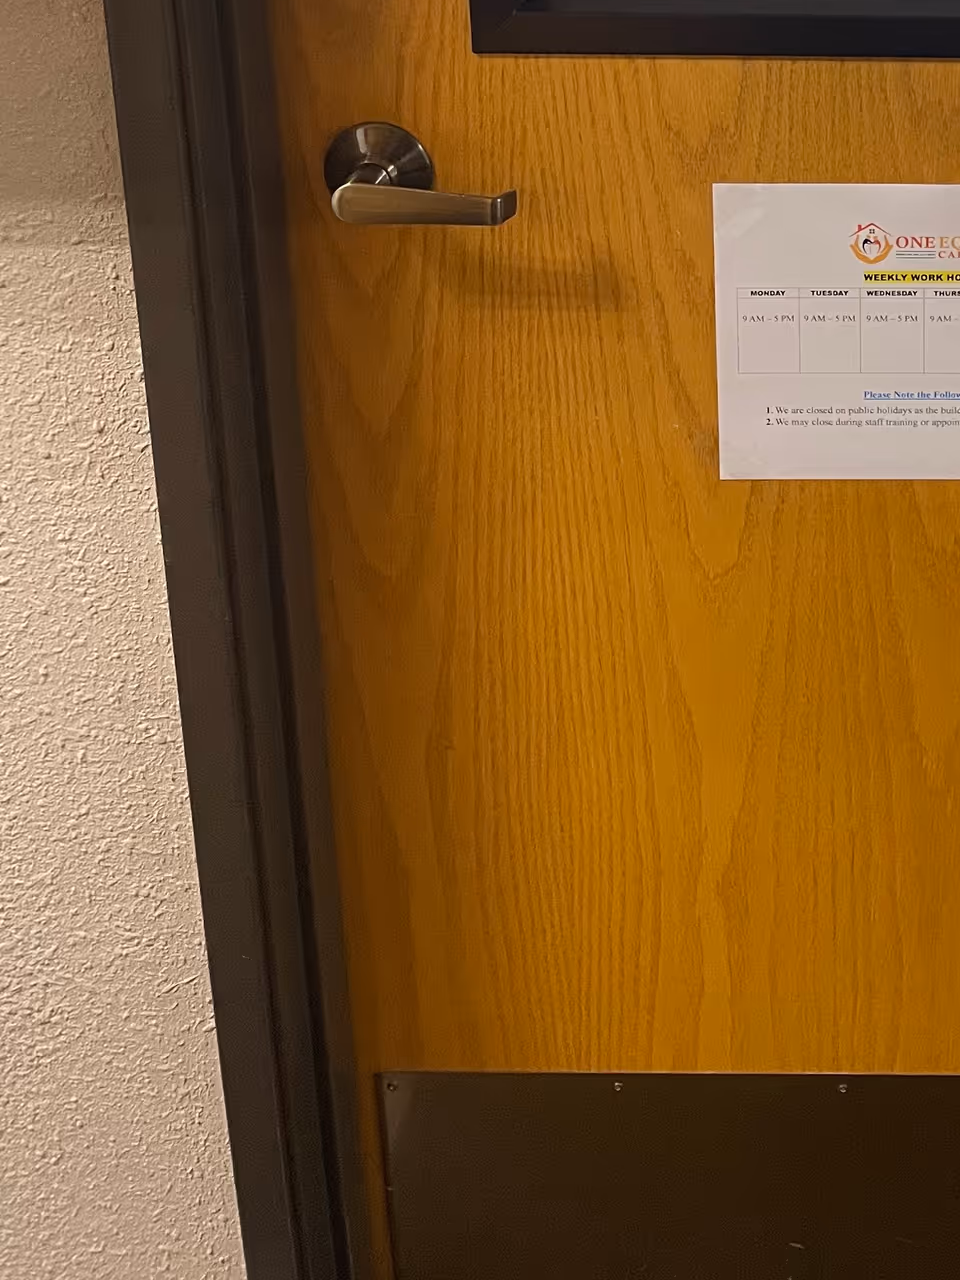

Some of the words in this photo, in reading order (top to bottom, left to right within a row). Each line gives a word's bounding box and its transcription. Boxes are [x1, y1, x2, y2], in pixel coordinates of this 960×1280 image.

[896, 236, 936, 249] ONE
[864, 274, 908, 282] WEEKLY
[910, 274, 944, 282] WORK
[864, 390, 891, 399] Please
[894, 390, 914, 399] Note
[917, 390, 931, 399] the
[848, 406, 874, 416] public
[877, 406, 912, 416] holidays
[926, 406, 938, 414] the
[836, 418, 862, 427] during
[886, 418, 918, 428] training
